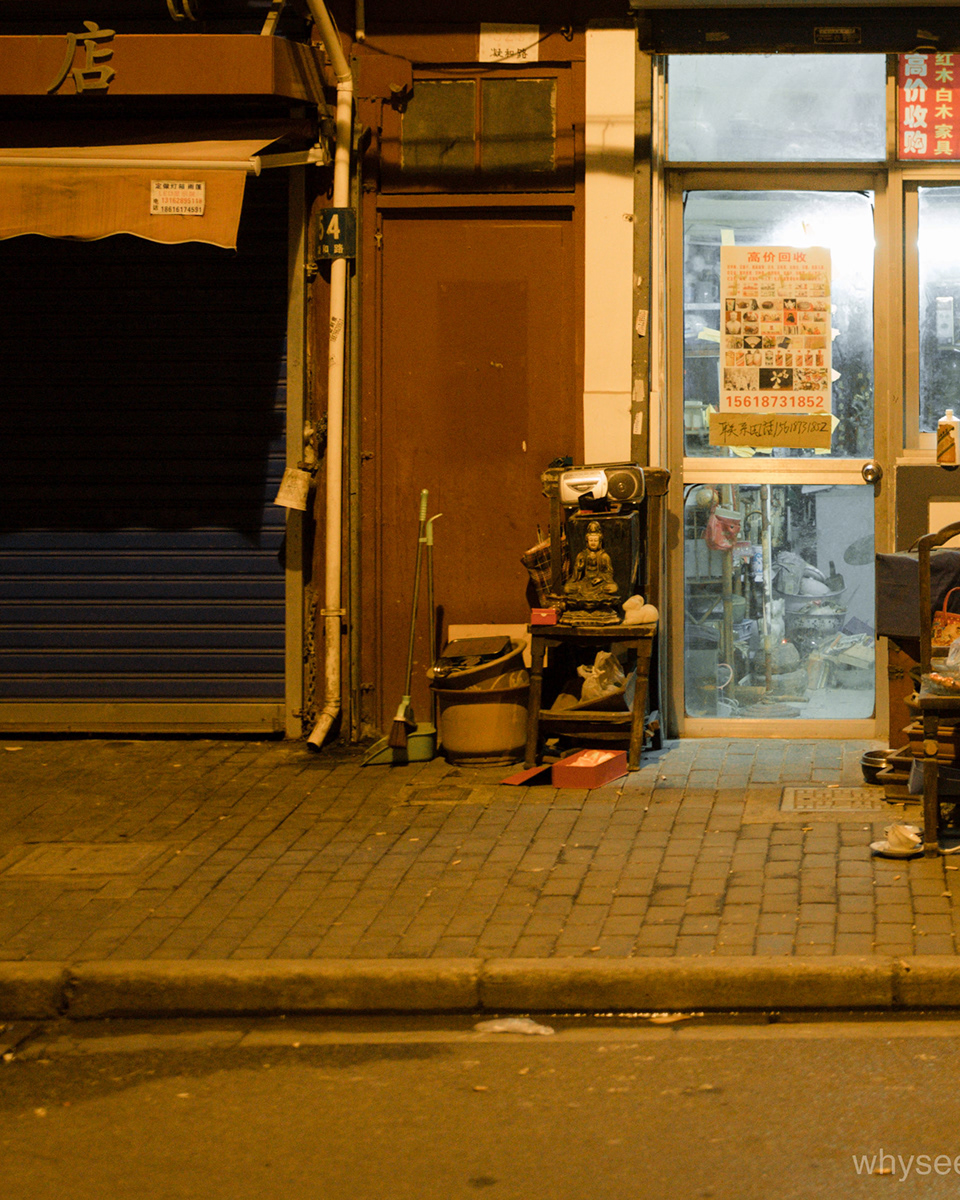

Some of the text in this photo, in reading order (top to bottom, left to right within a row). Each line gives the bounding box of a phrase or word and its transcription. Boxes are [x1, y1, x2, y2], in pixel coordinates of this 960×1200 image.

[47, 20, 116, 95] 店
[903, 53, 928, 154] 高价收购
[934, 53, 954, 156] 红木白木家具
[747, 251, 807, 263] 高价回收
[726, 395, 824, 408] 15618731852
